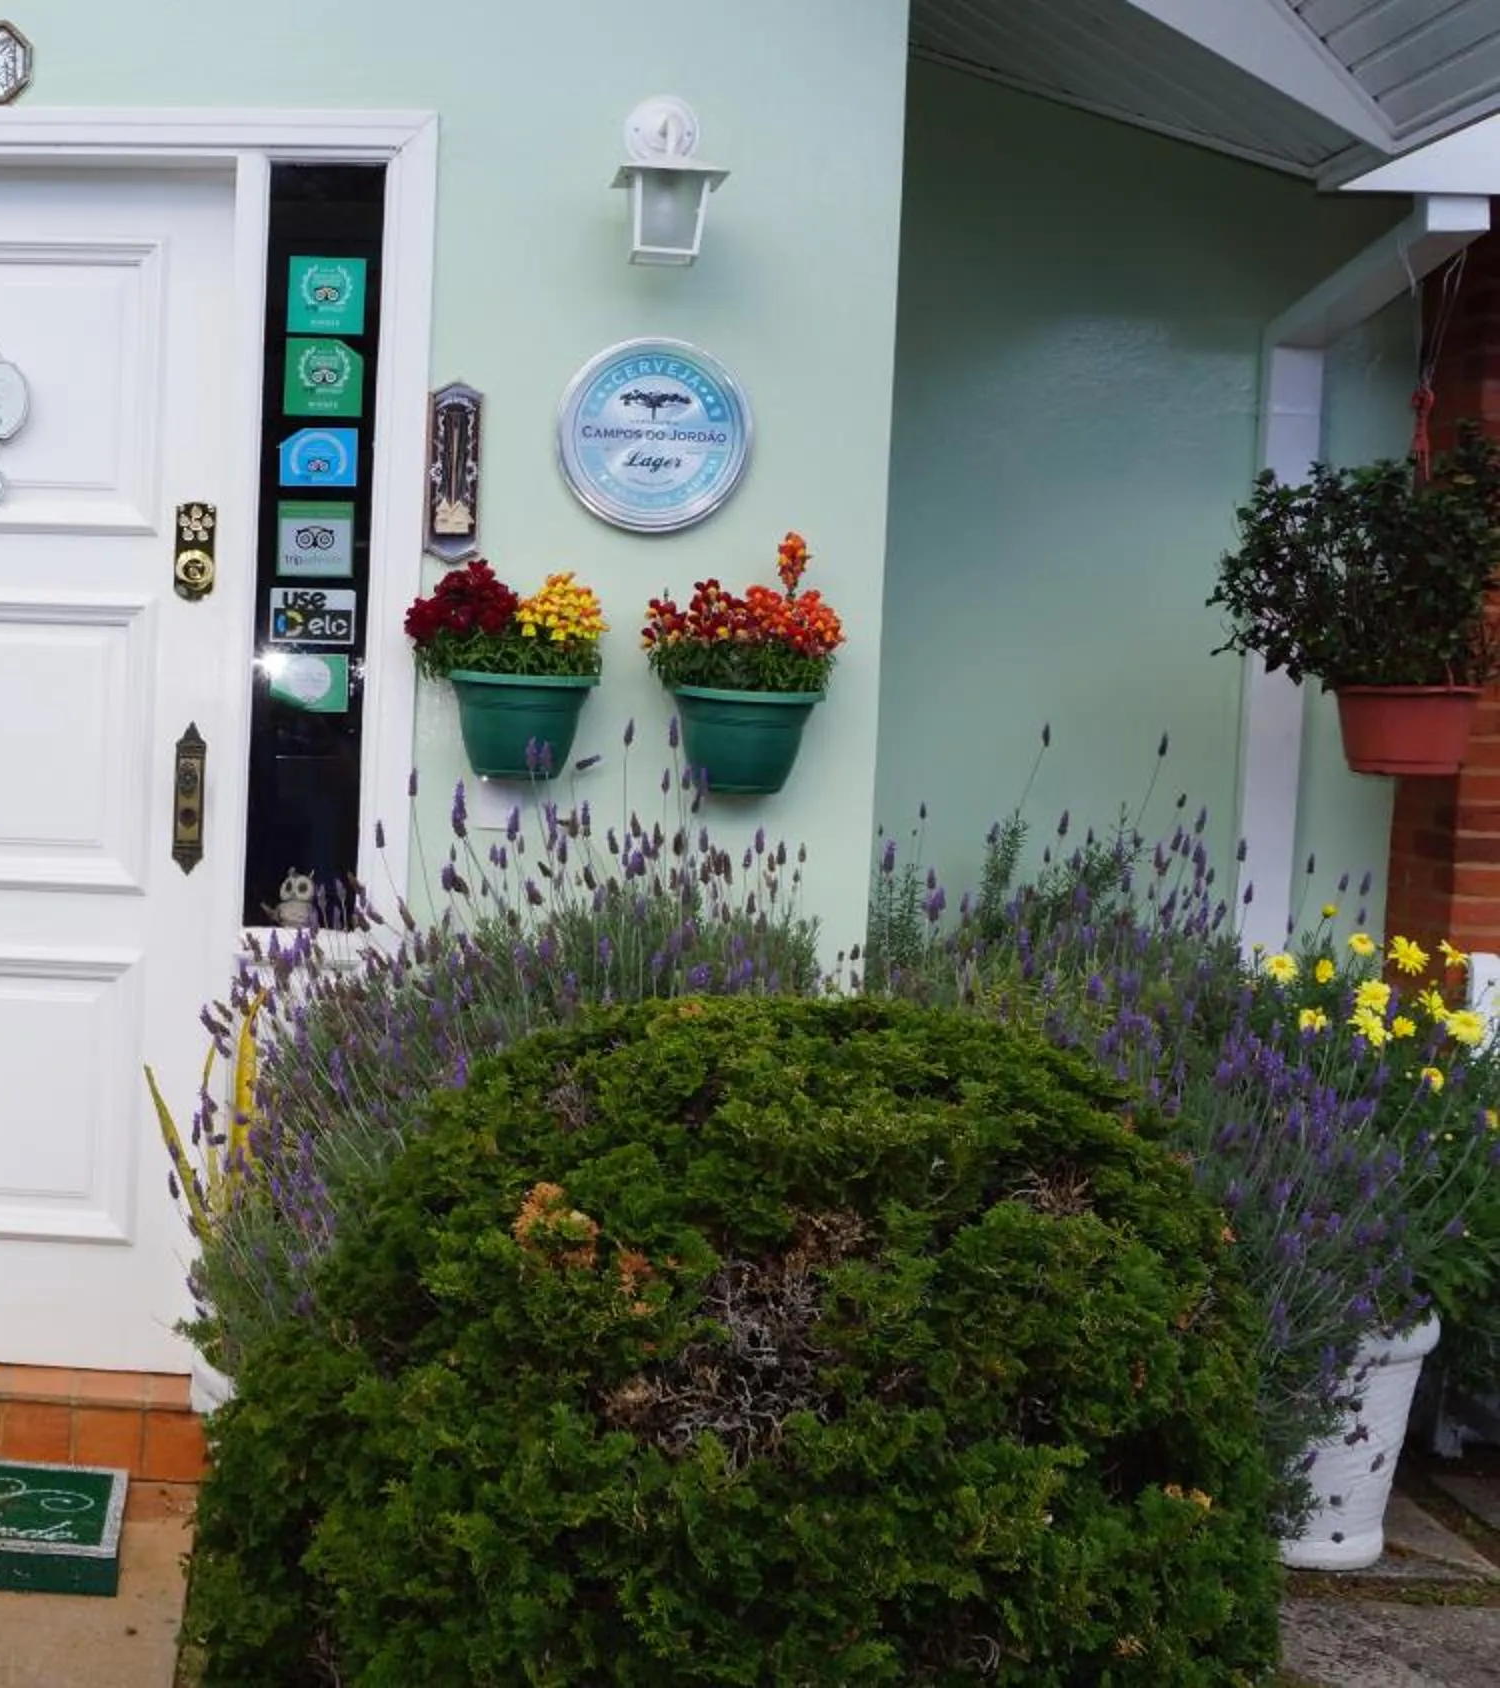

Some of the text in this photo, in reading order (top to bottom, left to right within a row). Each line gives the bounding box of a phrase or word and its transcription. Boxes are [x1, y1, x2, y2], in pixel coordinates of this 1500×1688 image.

[611, 359, 700, 389] CERVEJA
[622, 450, 682, 473] Lager
[283, 591, 327, 609] use
